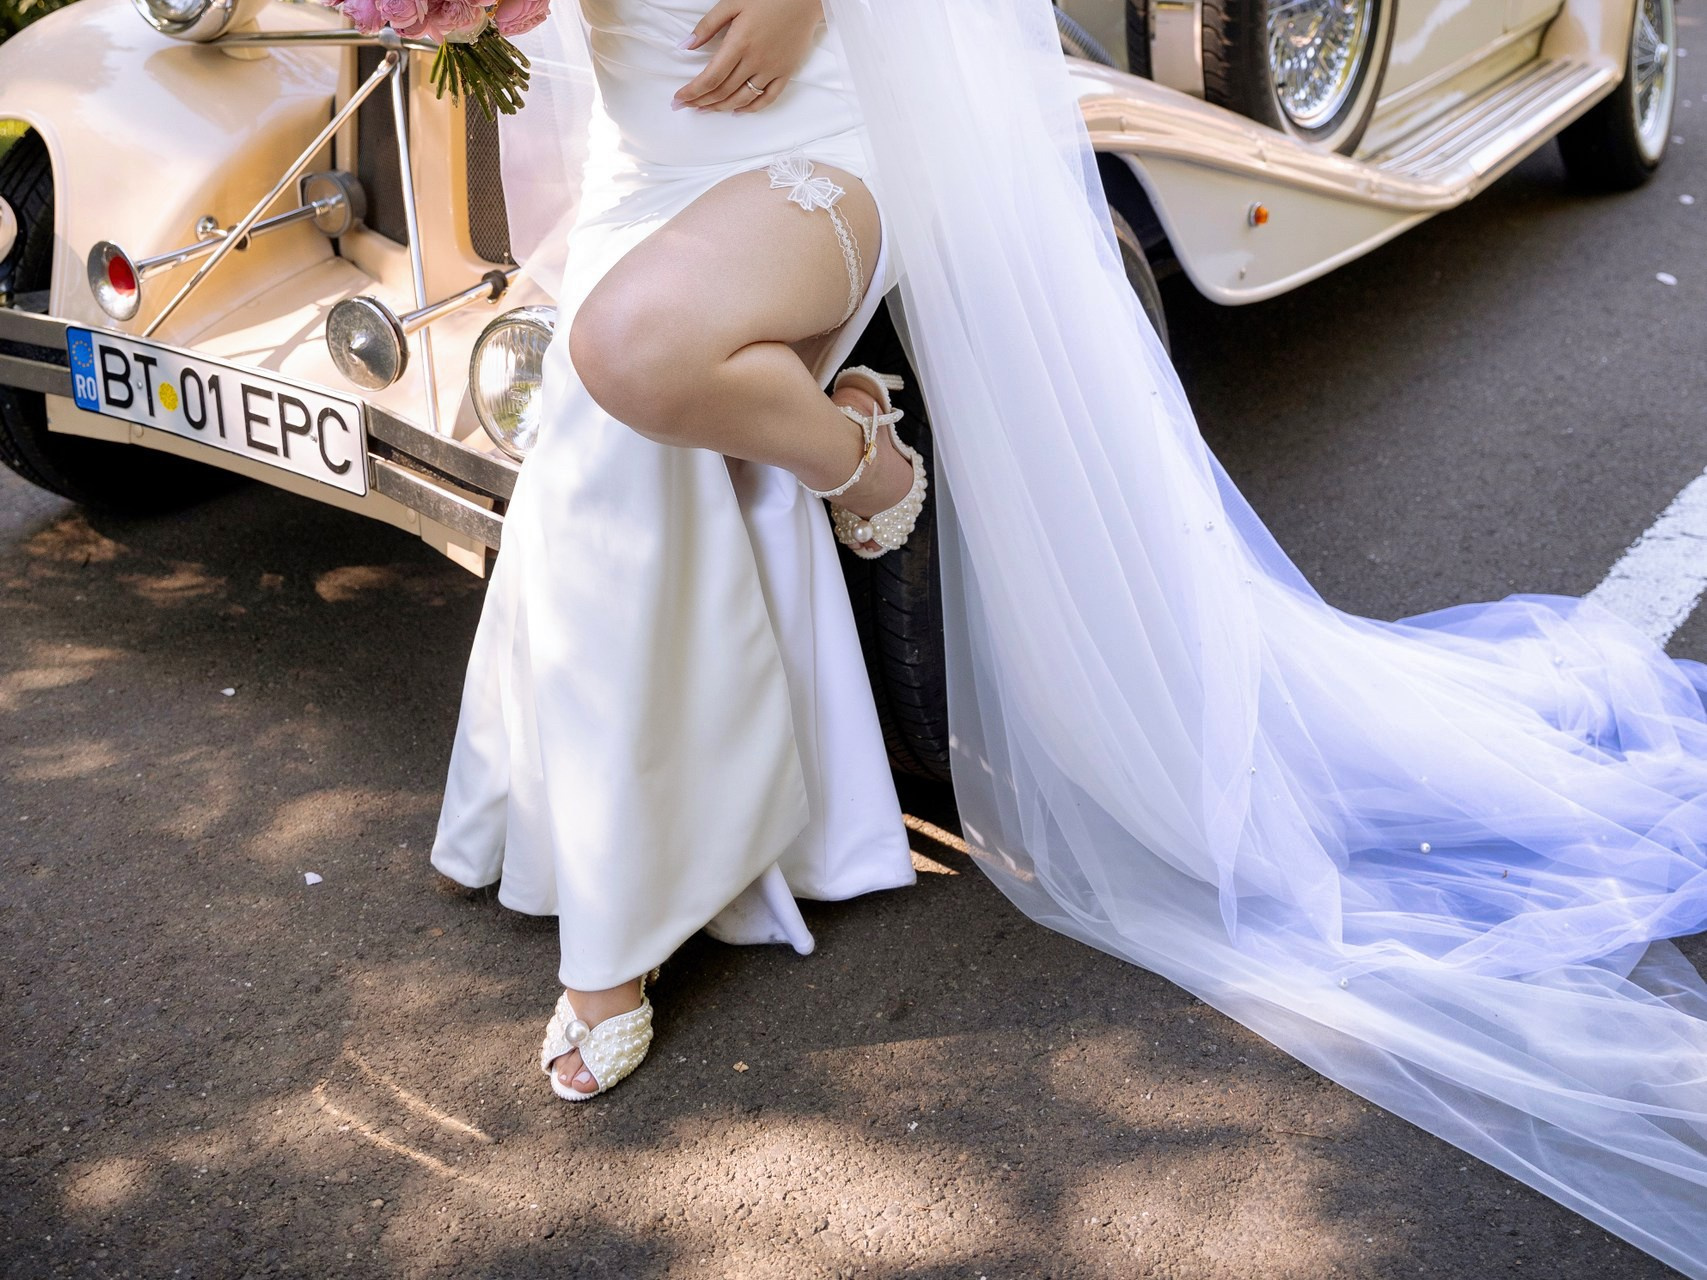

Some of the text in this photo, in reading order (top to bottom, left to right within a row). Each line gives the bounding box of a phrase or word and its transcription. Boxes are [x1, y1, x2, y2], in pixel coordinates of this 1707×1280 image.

[76, 373, 97, 402] RO
[99, 344, 351, 474] BT 01 EPC
